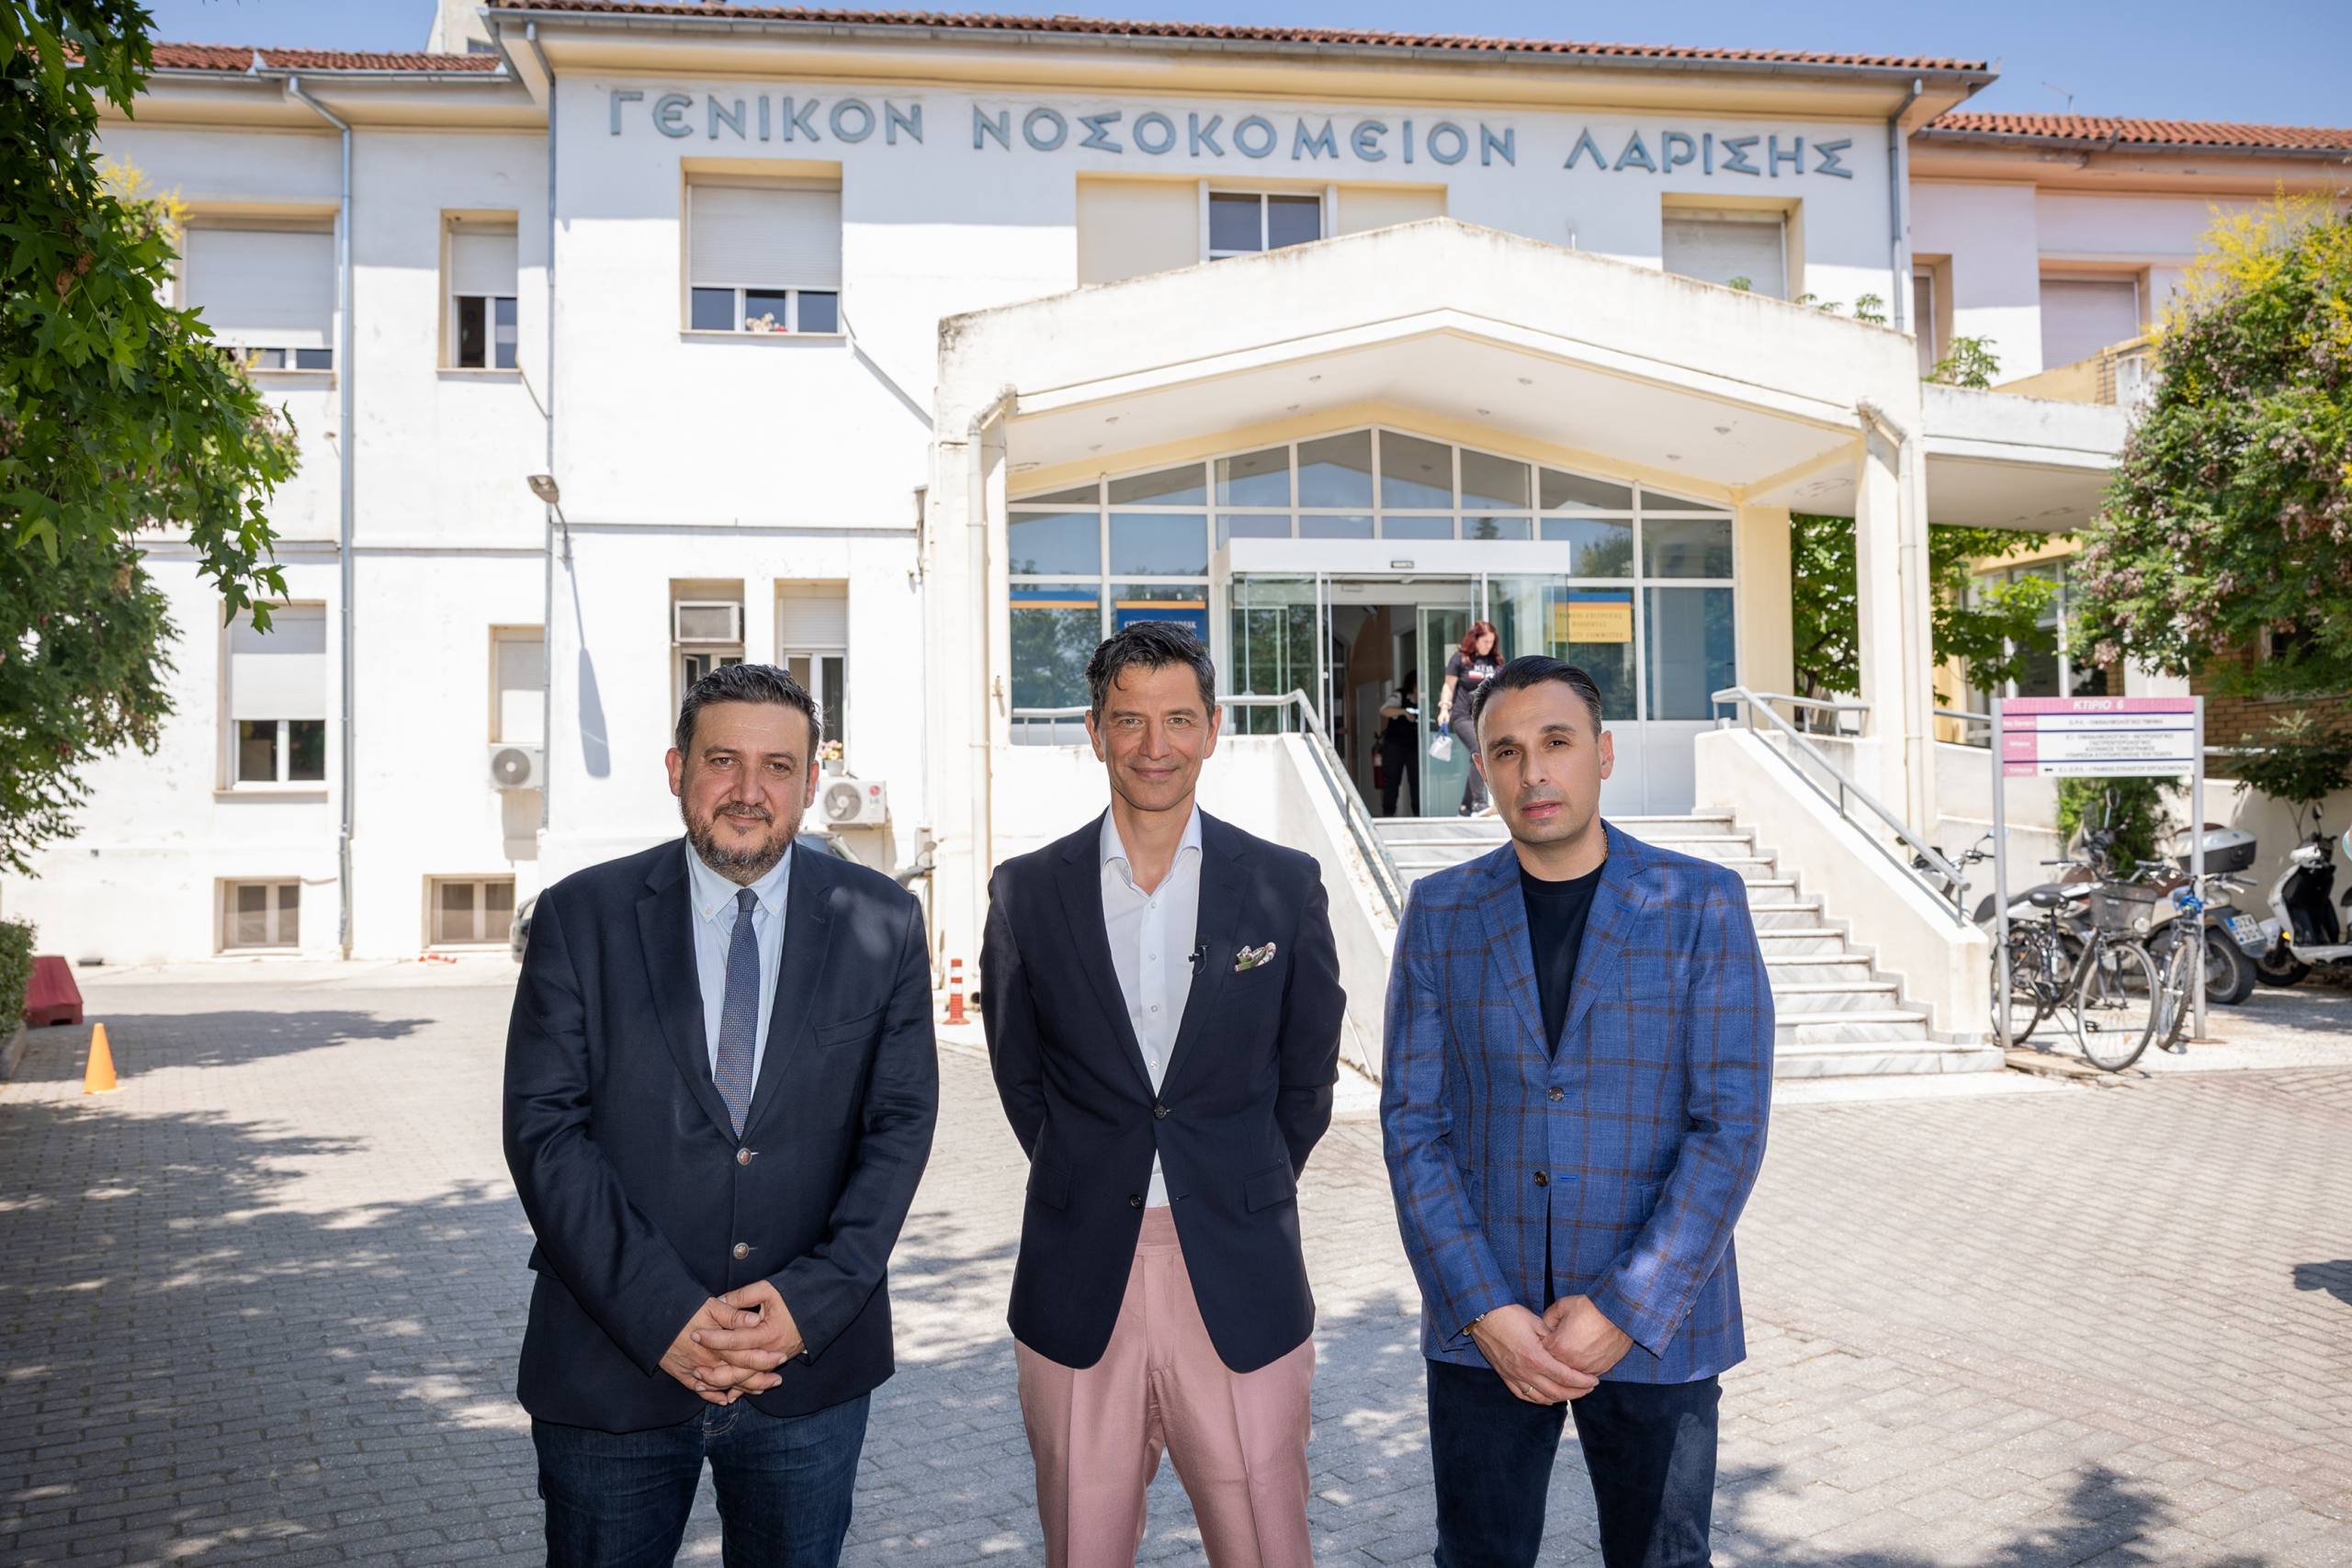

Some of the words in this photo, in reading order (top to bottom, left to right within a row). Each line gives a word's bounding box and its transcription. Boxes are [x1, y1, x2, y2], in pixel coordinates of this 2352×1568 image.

[609, 90, 923, 145] ΓΕΝΙΚΟΝ
[972, 104, 1516, 167] ΝΟΣΟΚΟΜΕΙΟΝ
[1564, 126, 1853, 179] ΛΑΡΙΣΗΣ
